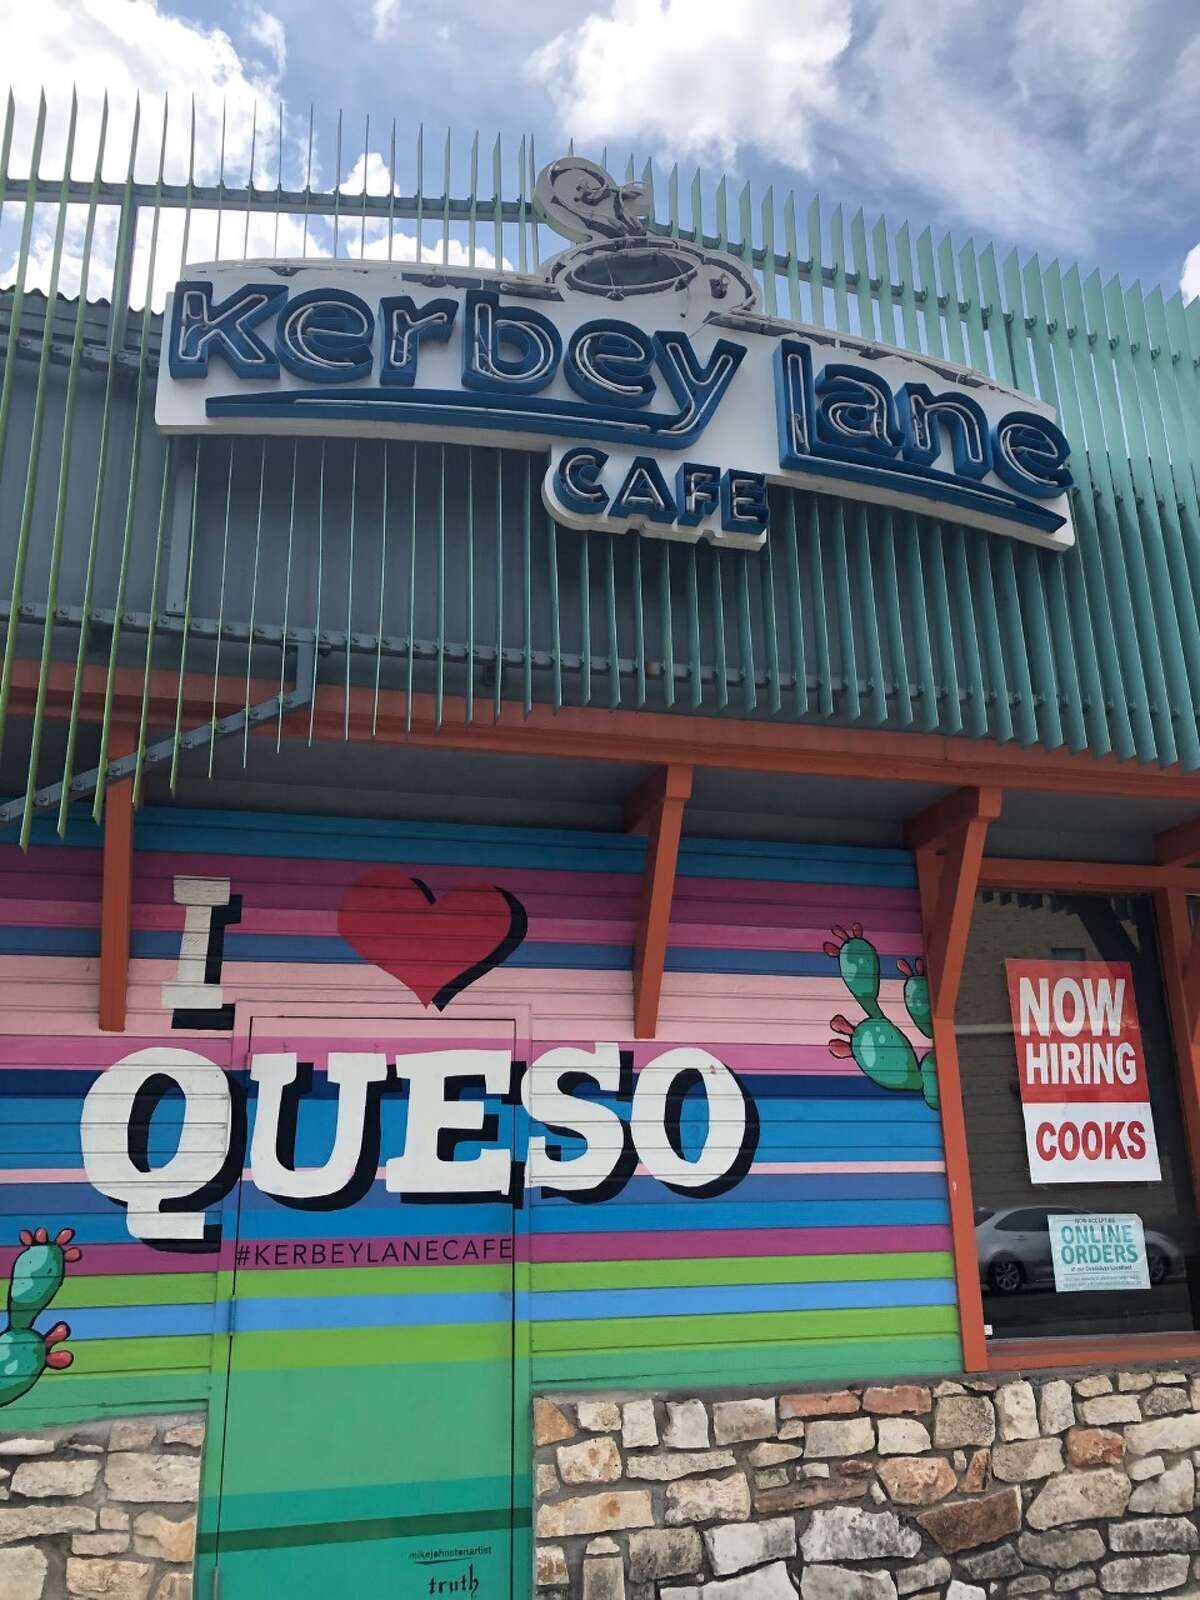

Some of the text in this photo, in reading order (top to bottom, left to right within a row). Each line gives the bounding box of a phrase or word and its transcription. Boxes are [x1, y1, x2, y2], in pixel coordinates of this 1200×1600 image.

[168, 281, 748, 448] Kerbey
[553, 446, 769, 535] CAFE
[161, 875, 236, 1022] I
[1019, 977, 1125, 1037] NOW
[1026, 1042, 1137, 1085] HIRING
[80, 1042, 755, 1248] QUESO
[1035, 1120, 1147, 1161] COOKS
[235, 1238, 512, 1266] #KERBEYLANECAFE
[1060, 1244, 1139, 1264] ORDERS
[1061, 1224, 1134, 1244] ONLINE
[427, 1563, 480, 1600] truth
